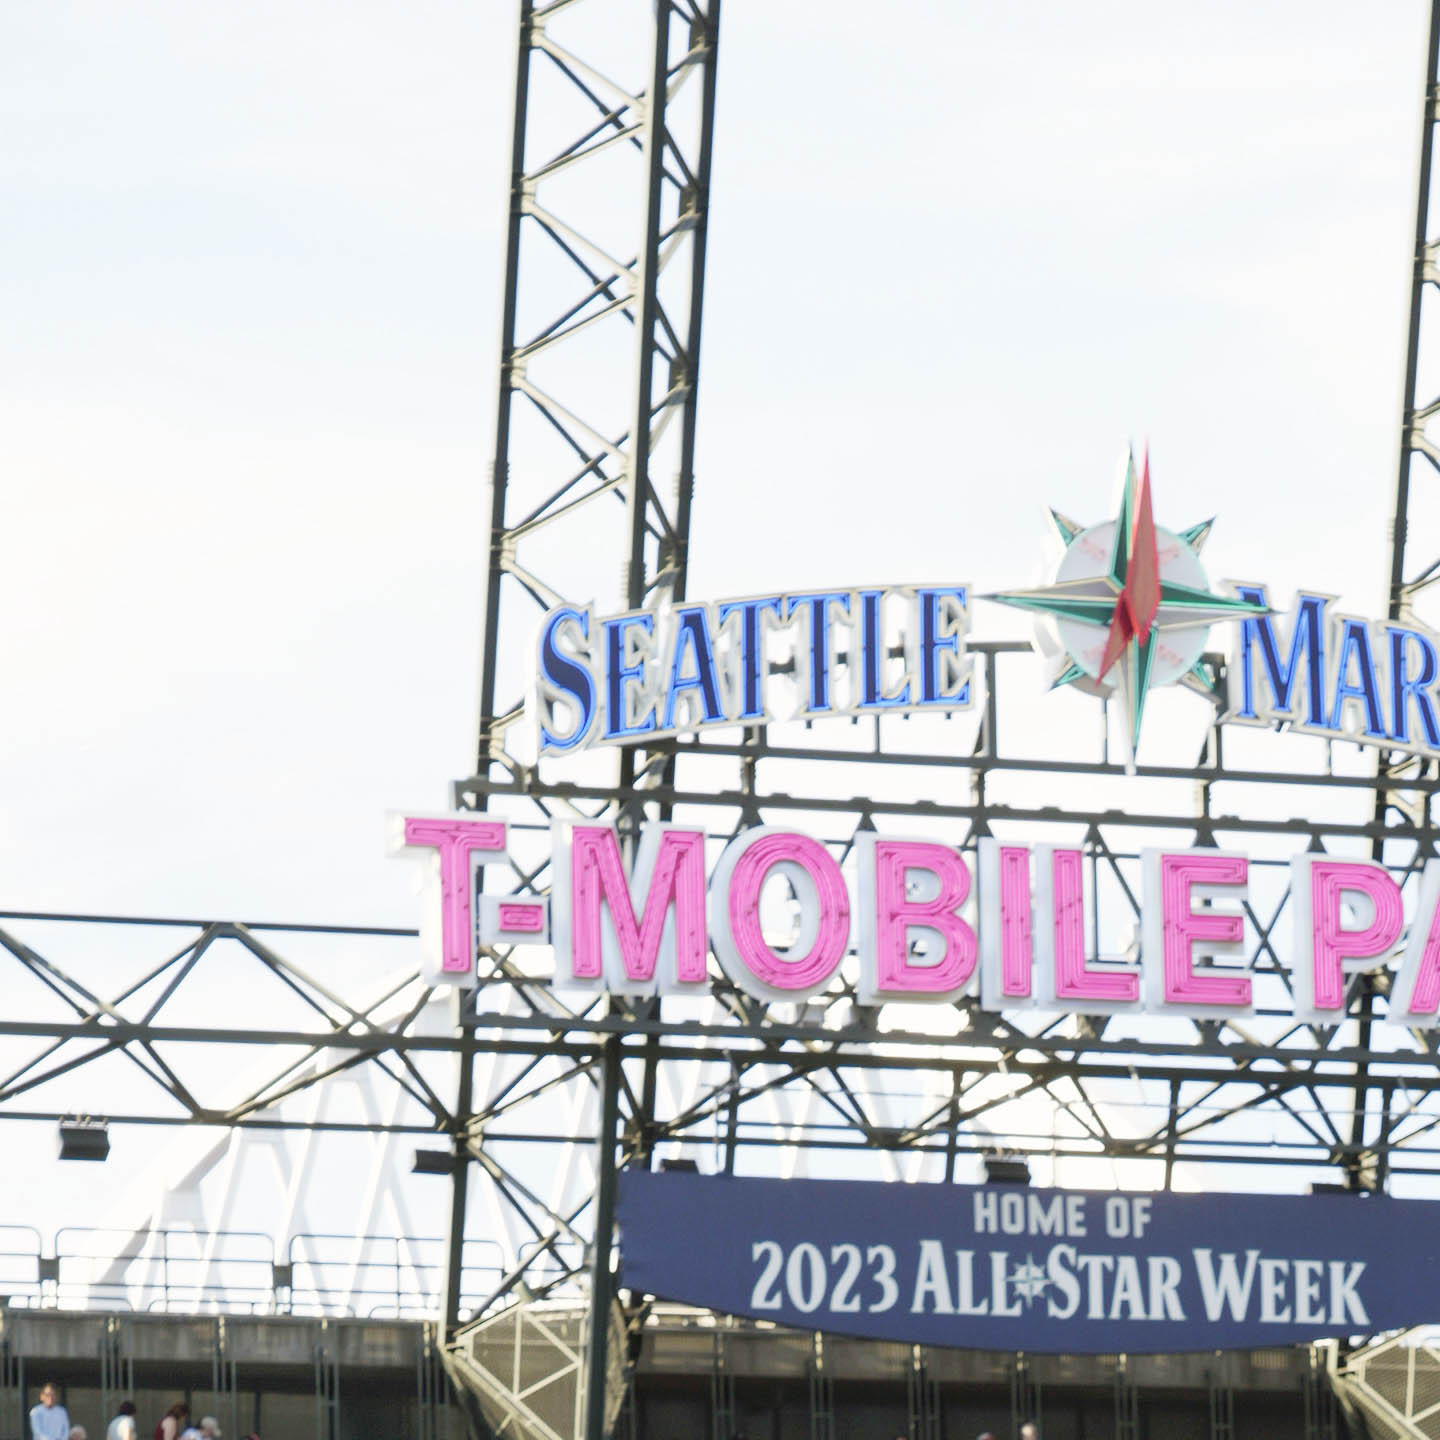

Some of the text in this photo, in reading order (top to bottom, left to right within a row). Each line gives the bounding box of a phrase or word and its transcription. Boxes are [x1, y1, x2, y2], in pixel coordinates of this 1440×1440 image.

[536, 585, 974, 754] SEATTLE
[401, 816, 1252, 1003] T-MOBILE
[974, 1192, 1152, 1238] HOME OF
[751, 1239, 1371, 1326] 2023 ALL STAR WEEK
